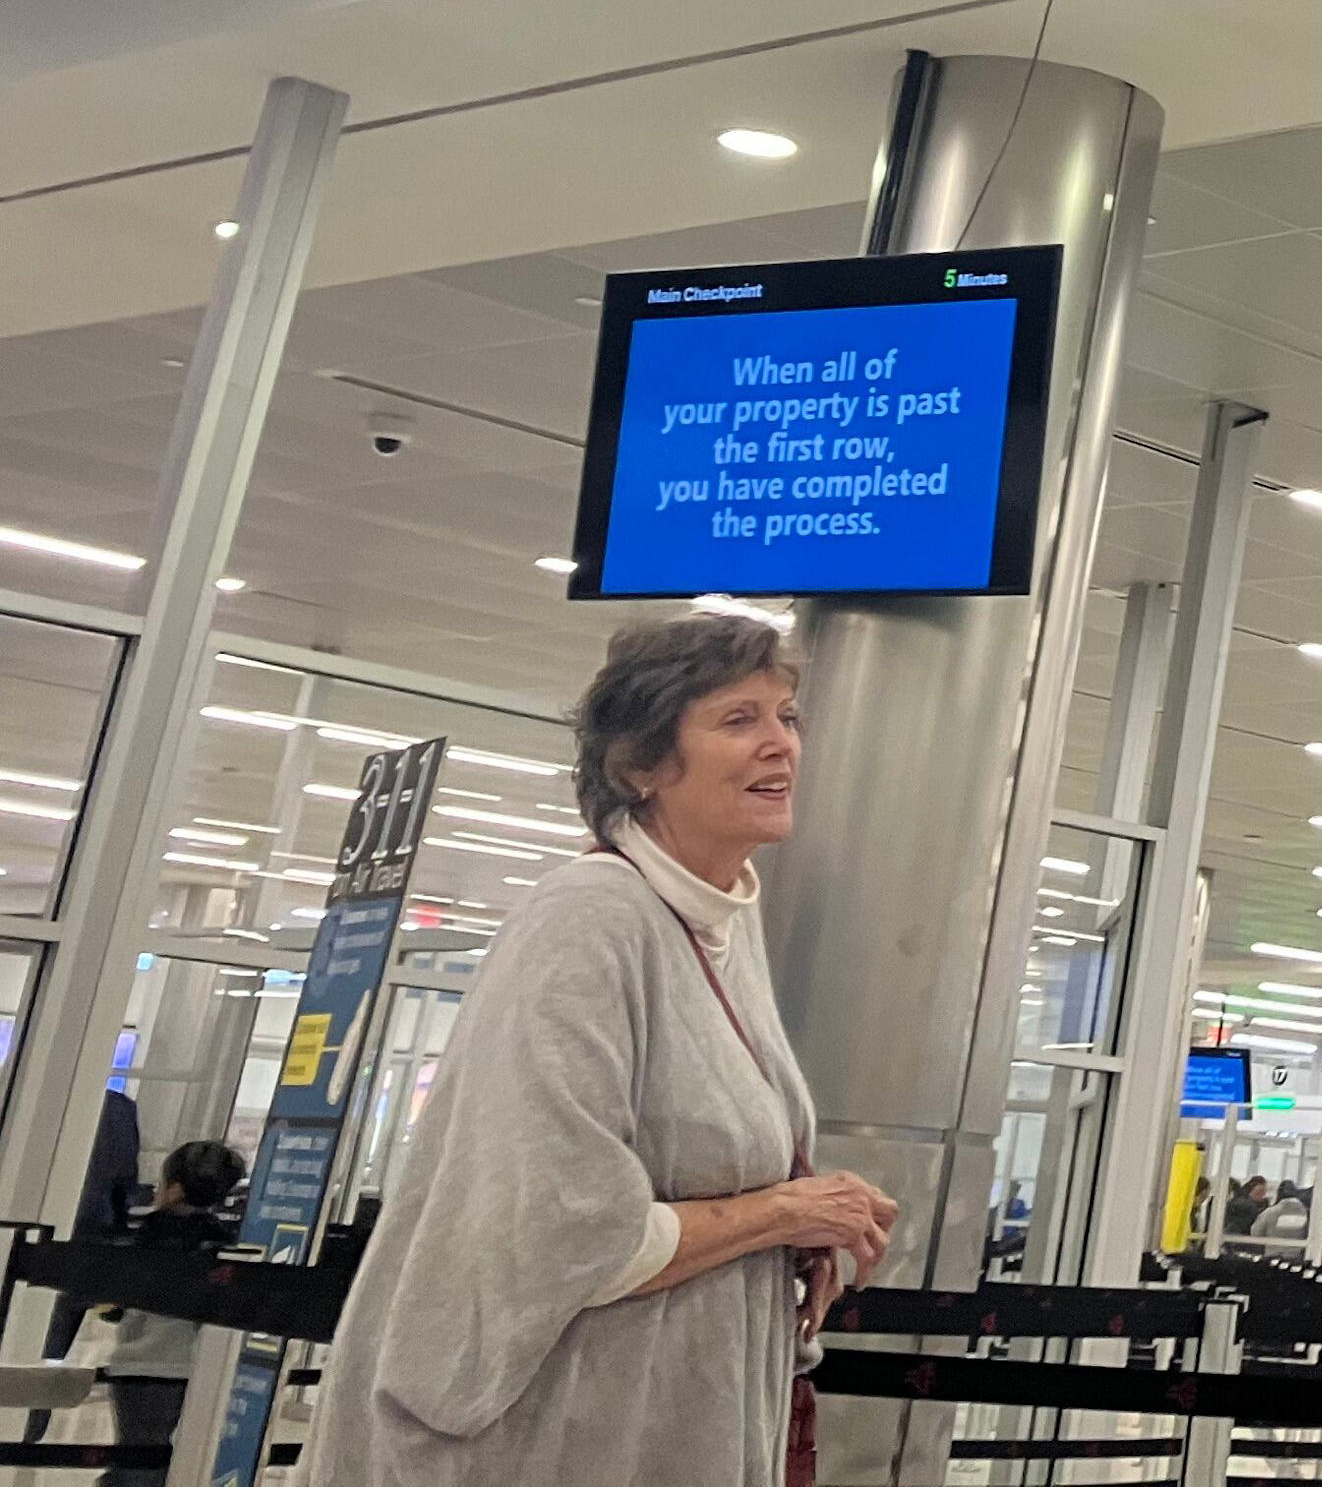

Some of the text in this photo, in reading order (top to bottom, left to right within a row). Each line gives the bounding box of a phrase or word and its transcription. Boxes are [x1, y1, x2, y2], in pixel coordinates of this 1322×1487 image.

[648, 283, 763, 304] Main Checkpoint
[944, 269, 1008, 288] 5 Minutes
[733, 349, 898, 386] When all of
[661, 386, 961, 434] your property is past
[713, 431, 895, 464] the first row,
[656, 463, 949, 511] you have completed
[711, 508, 881, 545] the process.
